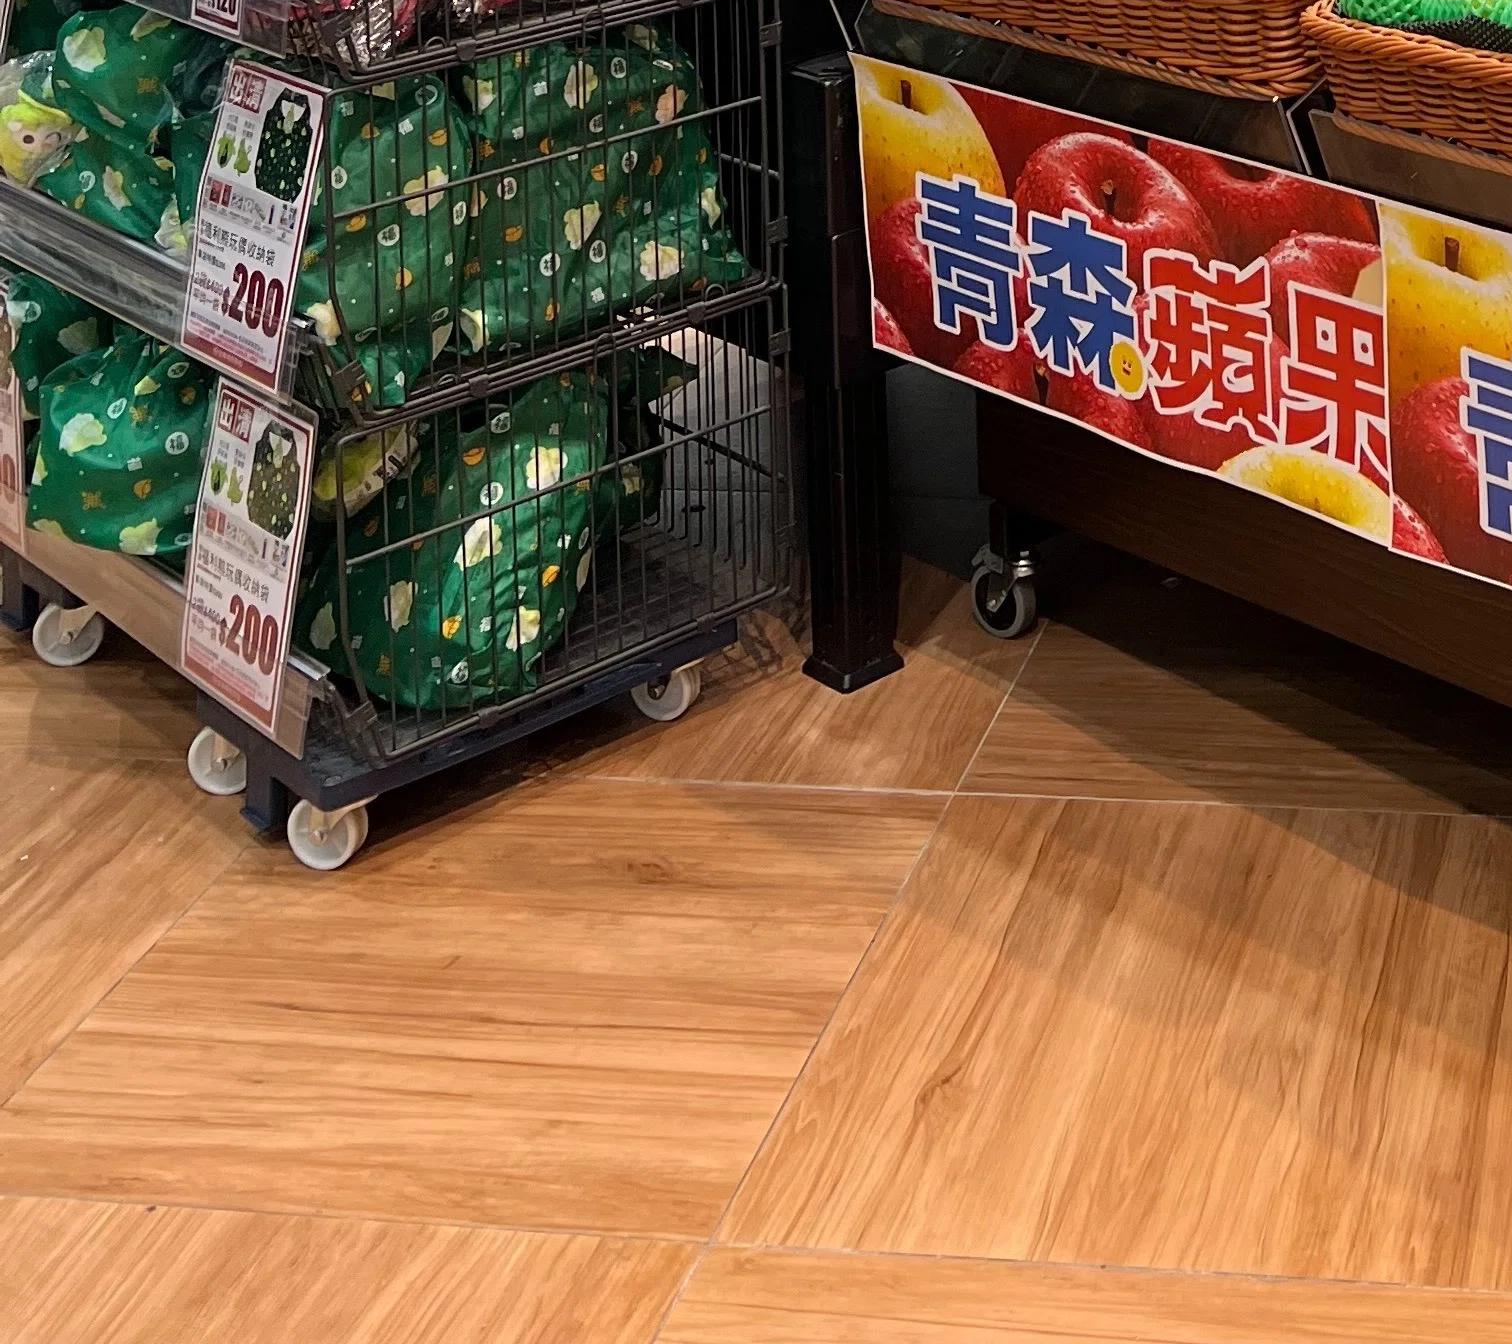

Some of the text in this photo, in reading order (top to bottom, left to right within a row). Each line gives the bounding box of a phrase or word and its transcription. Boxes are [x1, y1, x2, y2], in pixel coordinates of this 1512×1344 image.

[218, 390, 254, 443] 出清
[914, 170, 1389, 481] 青森蘋果
